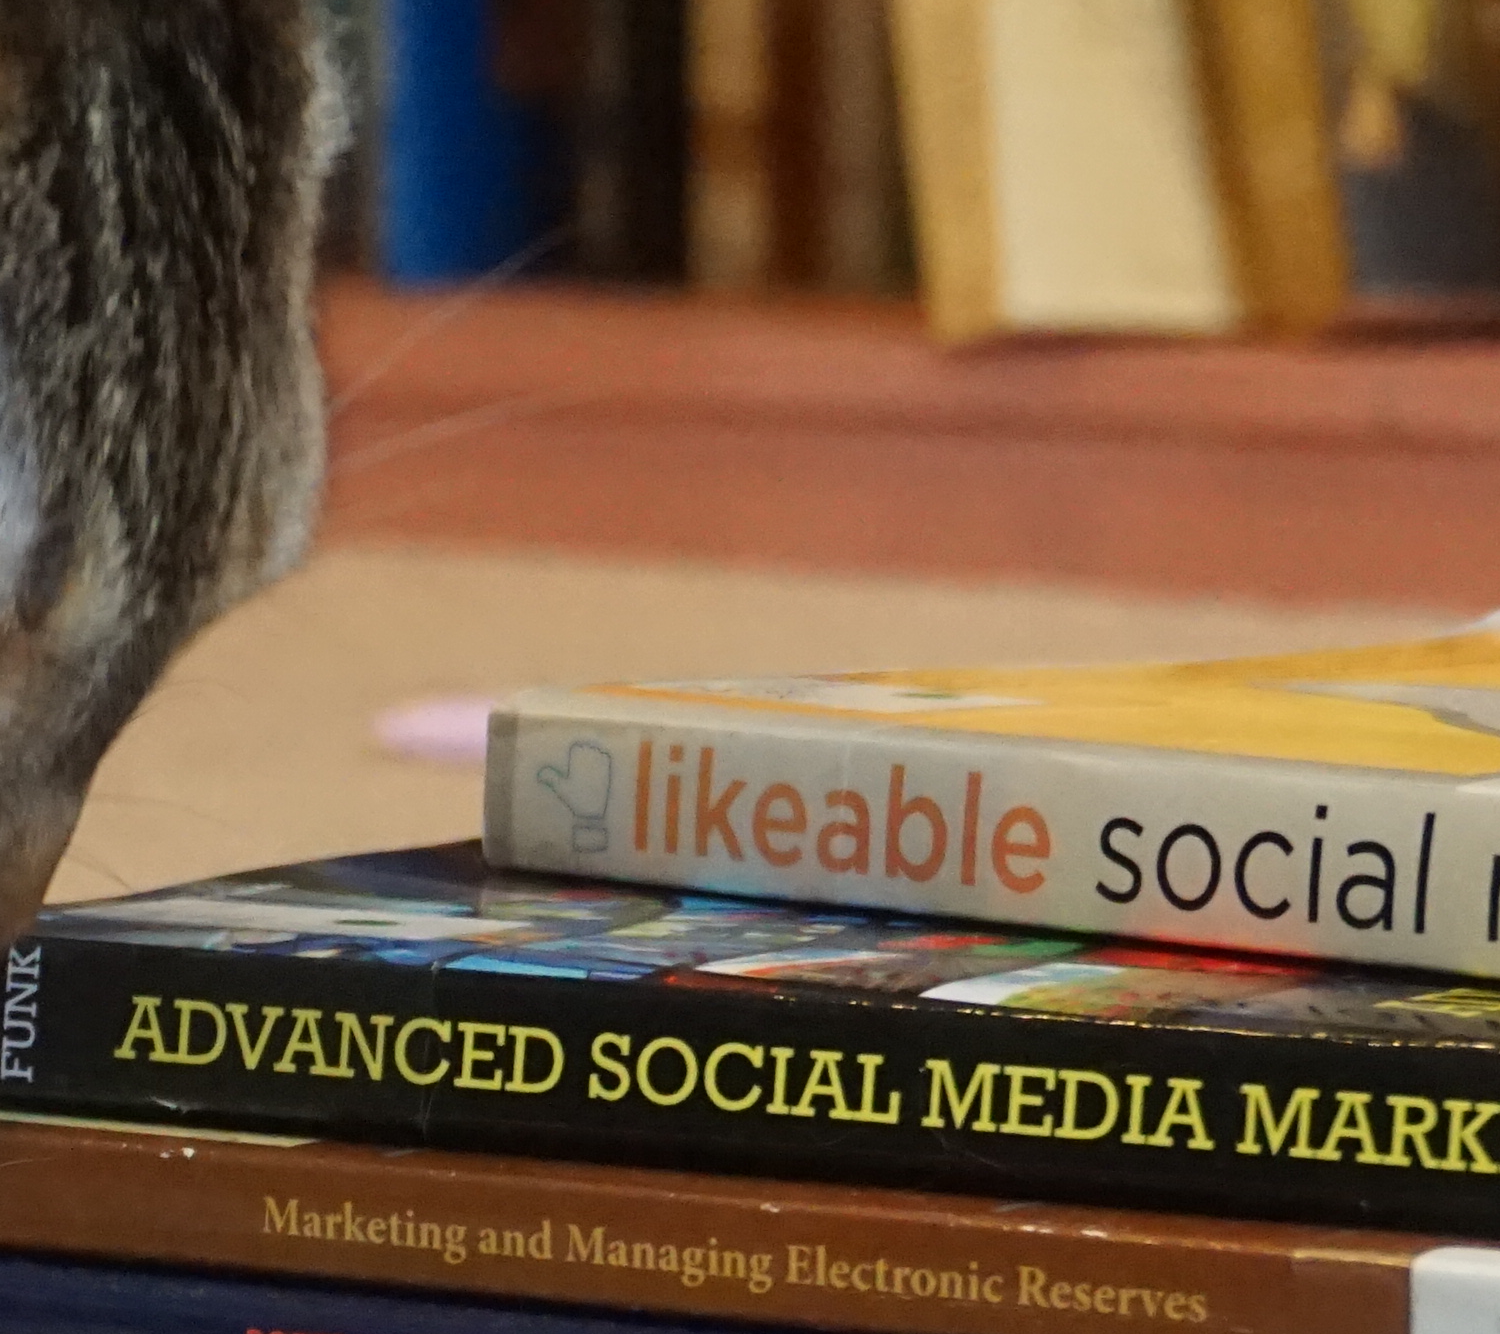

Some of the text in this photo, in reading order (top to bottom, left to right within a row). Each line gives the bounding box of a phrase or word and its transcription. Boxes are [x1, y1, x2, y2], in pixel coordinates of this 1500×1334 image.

[633, 740, 1051, 894] likeable
[1096, 805, 1436, 934] social
[2, 943, 43, 1084] FUNK
[114, 995, 565, 1095] ADVANCED
[589, 1032, 901, 1124] SOCIAL
[922, 1059, 1213, 1151] MEDIA
[263, 1196, 1208, 1323] Marketing and Managing Electronic Reserves
